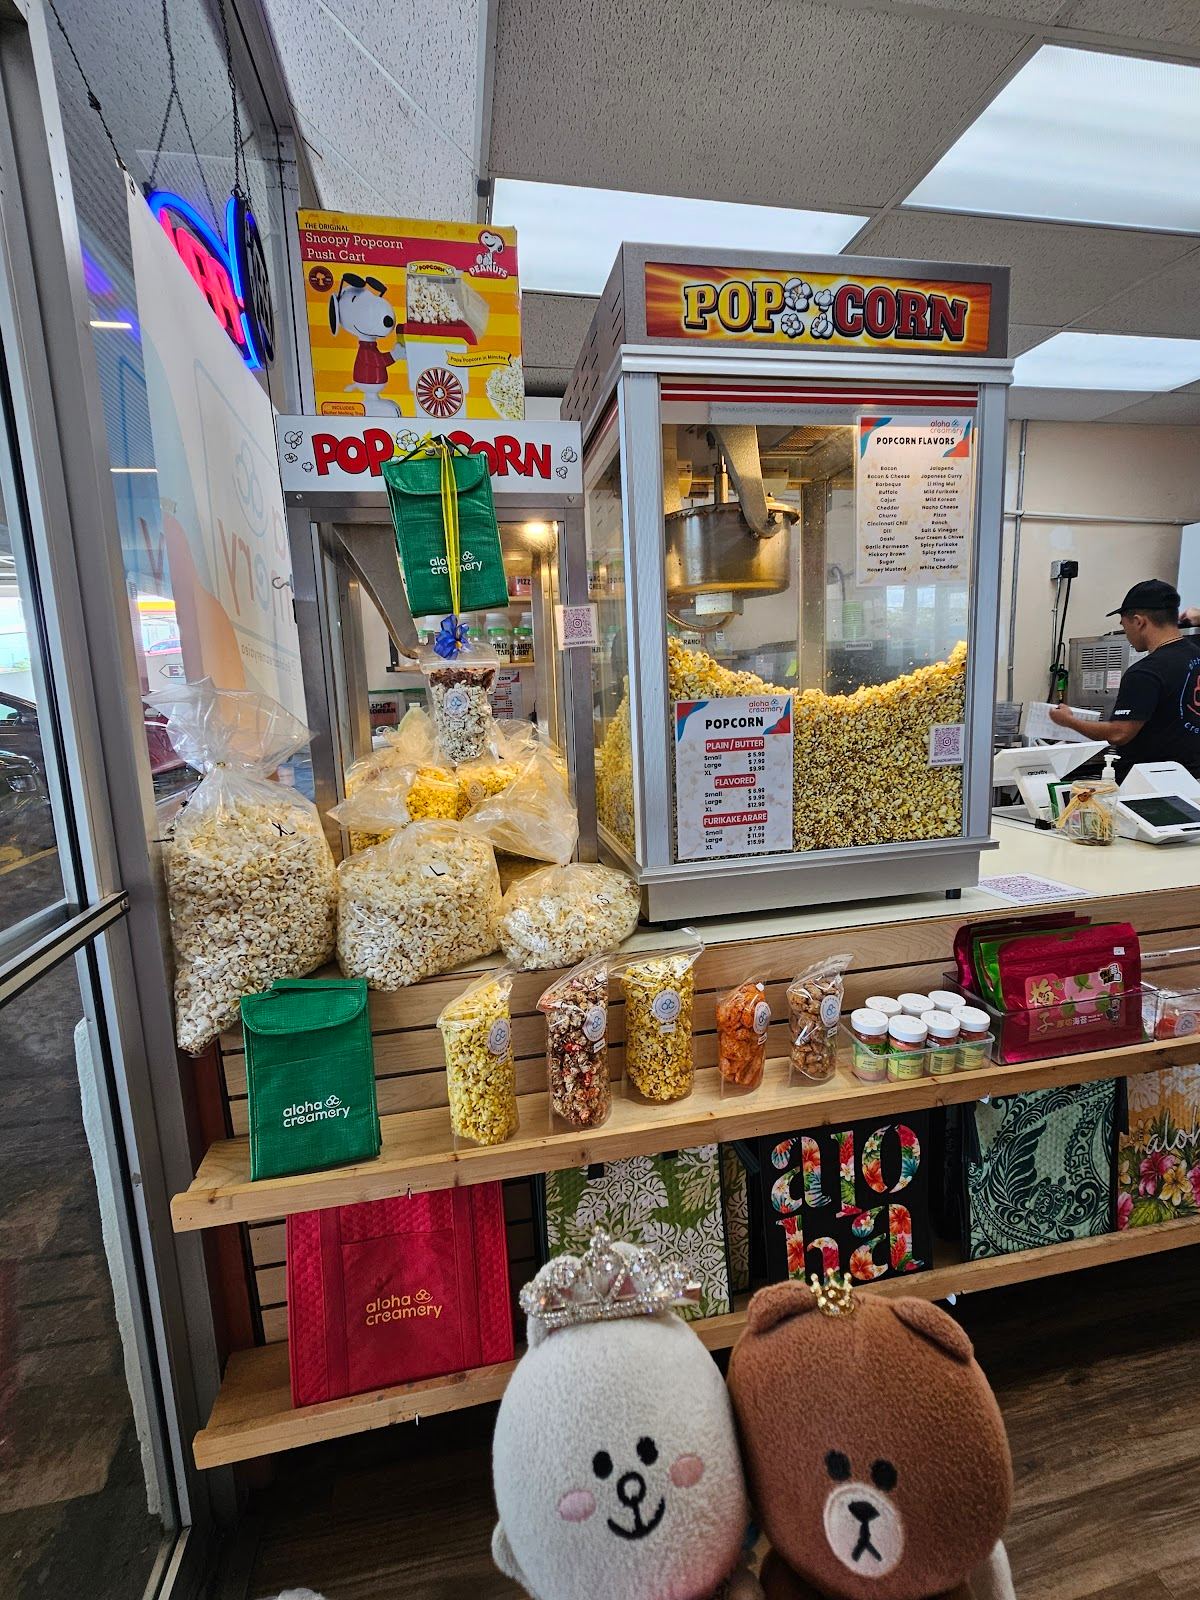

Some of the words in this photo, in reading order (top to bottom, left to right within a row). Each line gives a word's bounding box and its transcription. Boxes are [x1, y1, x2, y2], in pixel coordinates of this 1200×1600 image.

[304, 222, 318, 230] THE
[318, 223, 349, 231] ORIGINAL
[305, 232, 350, 248] Snoopy
[353, 235, 404, 249] Popcorn
[307, 248, 336, 260] Push
[339, 250, 366, 262] Cart
[469, 261, 508, 277] PEANUTS
[684, 280, 785, 333] POP
[832, 284, 969, 342] CORN
[930, 420, 951, 428] aloha
[930, 427, 963, 436] creamery
[876, 437, 916, 445] POPCORN
[918, 437, 955, 445] FLAVORS
[311, 428, 394, 477] POP
[431, 561, 482, 575] cremery
[748, 706, 783, 714] creamery
[705, 717, 764, 730] POPCORN
[706, 742, 729, 750] PLAIN
[735, 739, 764, 748] BUTTER
[715, 776, 755, 786] FLAVORED
[704, 815, 741, 826] FURIKAKE
[742, 812, 767, 822] ARARE
[282, 1101, 323, 1118] aloha
[282, 1106, 351, 1128] creamery
[366, 1294, 411, 1313] aloha
[366, 1305, 443, 1326] creamery
